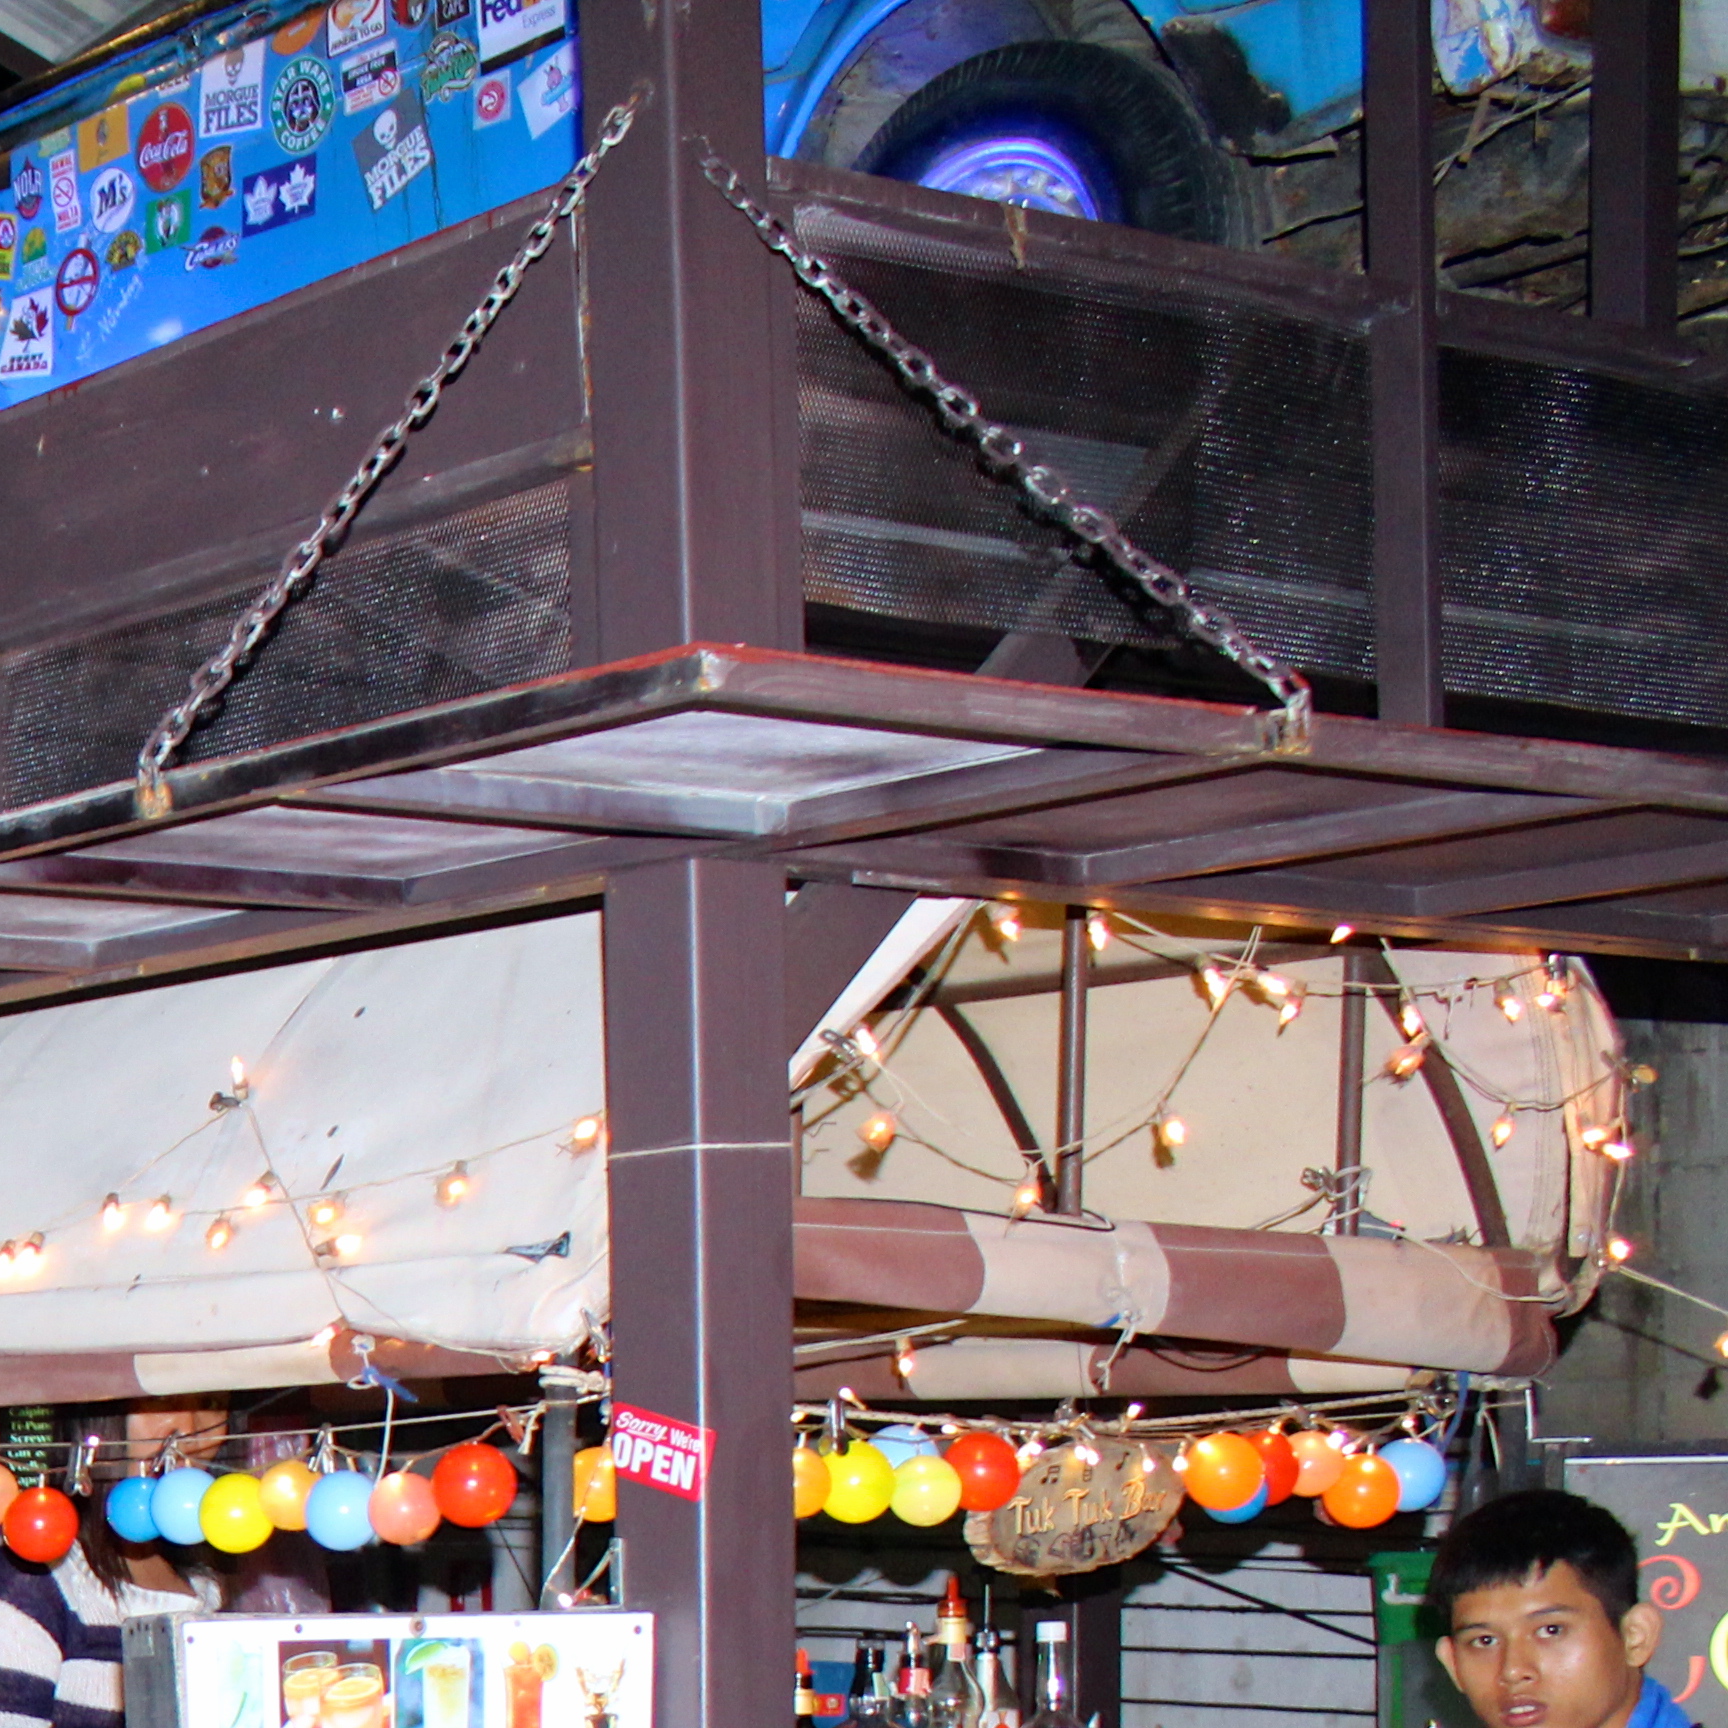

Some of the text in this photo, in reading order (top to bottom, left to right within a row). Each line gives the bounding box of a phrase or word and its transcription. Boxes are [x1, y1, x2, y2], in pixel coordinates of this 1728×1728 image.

[205, 84, 259, 106] MORGUE
[204, 102, 258, 133] FILES
[281, 119, 326, 149] COFFEE
[364, 124, 424, 184] MORGUE
[370, 144, 432, 210] FILES
[615, 1411, 669, 1442] Sorry
[613, 1431, 697, 1490] OPEN
